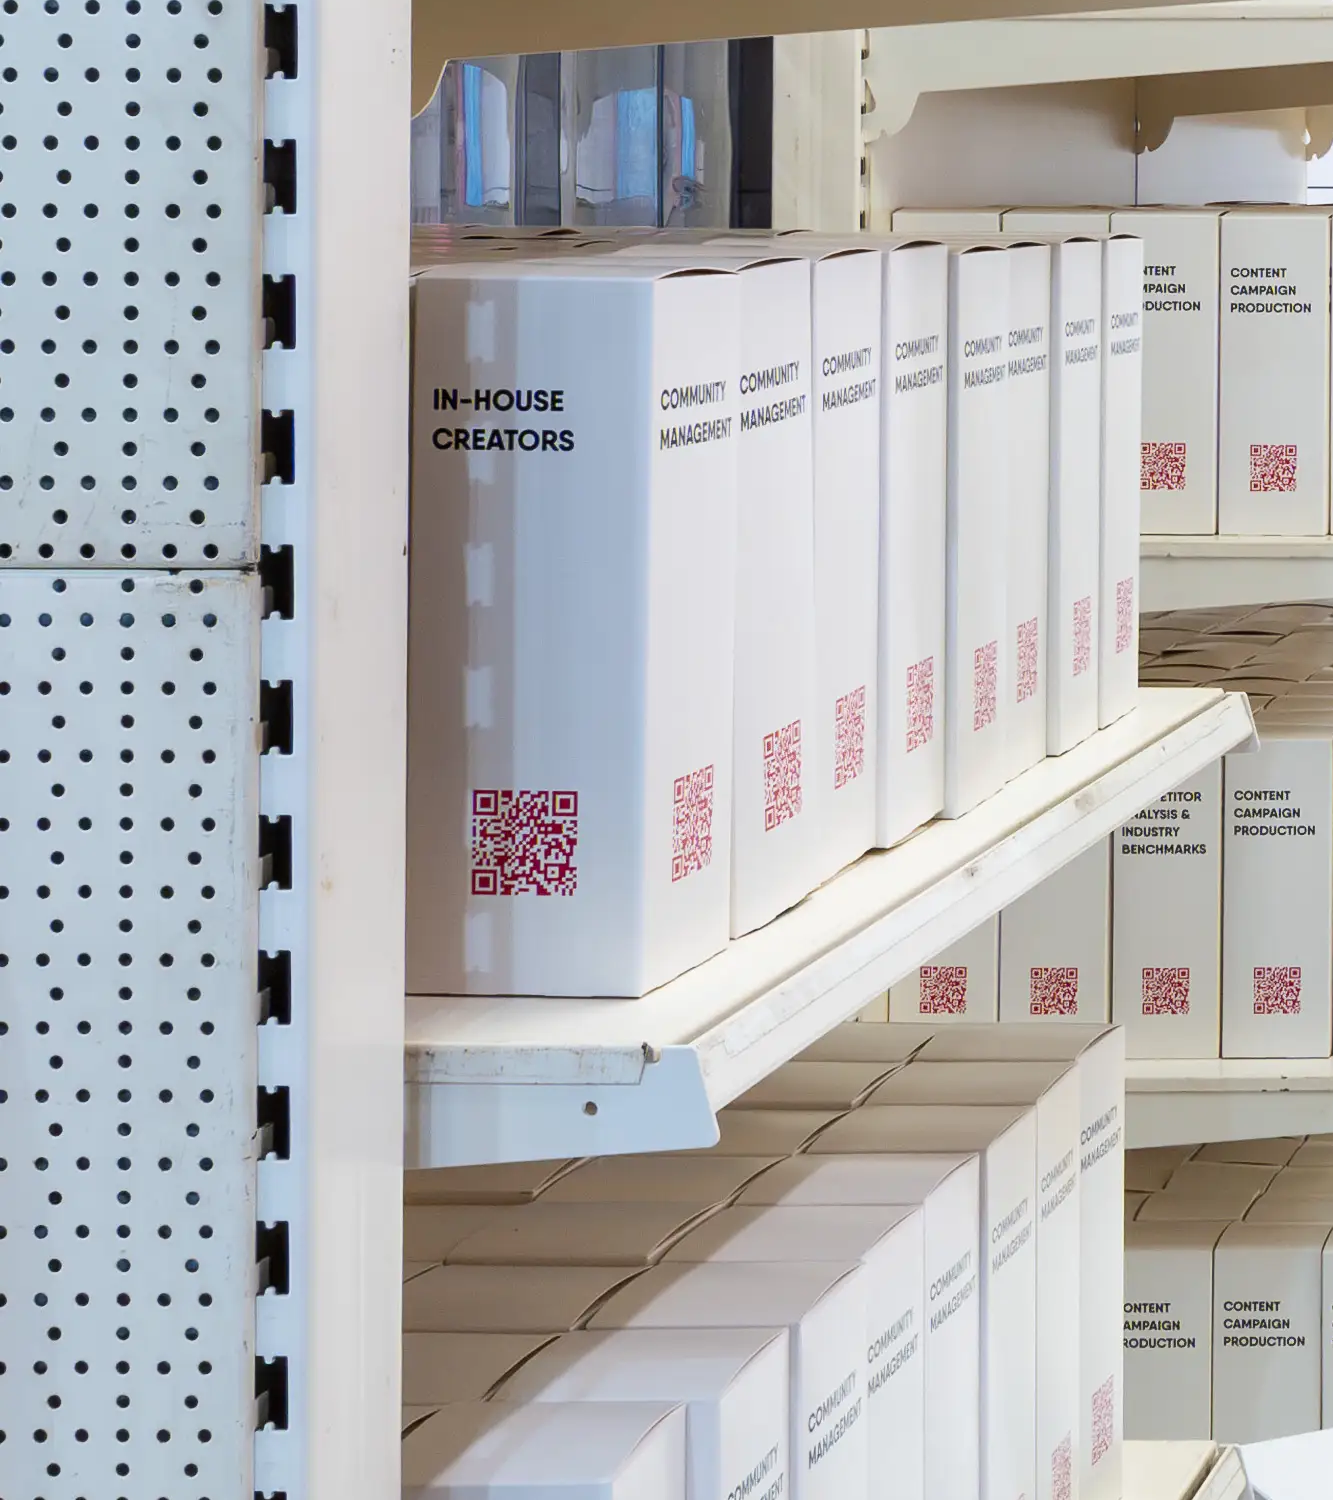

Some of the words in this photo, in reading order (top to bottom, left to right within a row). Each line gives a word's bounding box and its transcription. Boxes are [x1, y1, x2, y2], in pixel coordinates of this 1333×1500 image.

[1230, 267, 1287, 278] CONTENT
[1230, 284, 1296, 295] CAMPAIGN
[1230, 302, 1311, 313] PRODUCTION
[822, 347, 871, 377] COMMUNITY
[739, 361, 799, 395] COMMUNITY
[433, 388, 564, 412] IN-HOUSE
[660, 381, 726, 411] COMMUNITY
[822, 378, 876, 412] MANAGEMENT
[740, 394, 806, 431] MANAGEMENT
[432, 427, 574, 451] CREATORS
[659, 416, 731, 450] MANAGEMENT
[1233, 790, 1291, 801] CONTENT
[1233, 807, 1300, 818] CAMPAIGN
[1121, 826, 1180, 837] INDUSTRY
[1233, 824, 1315, 836] PRODUCTION
[1121, 843, 1206, 855] BENCHMARKS
[1223, 1300, 1280, 1312] CONTENT
[1223, 1318, 1290, 1329] CAMPAIGN
[1223, 1335, 1305, 1347] PRODUCTION
